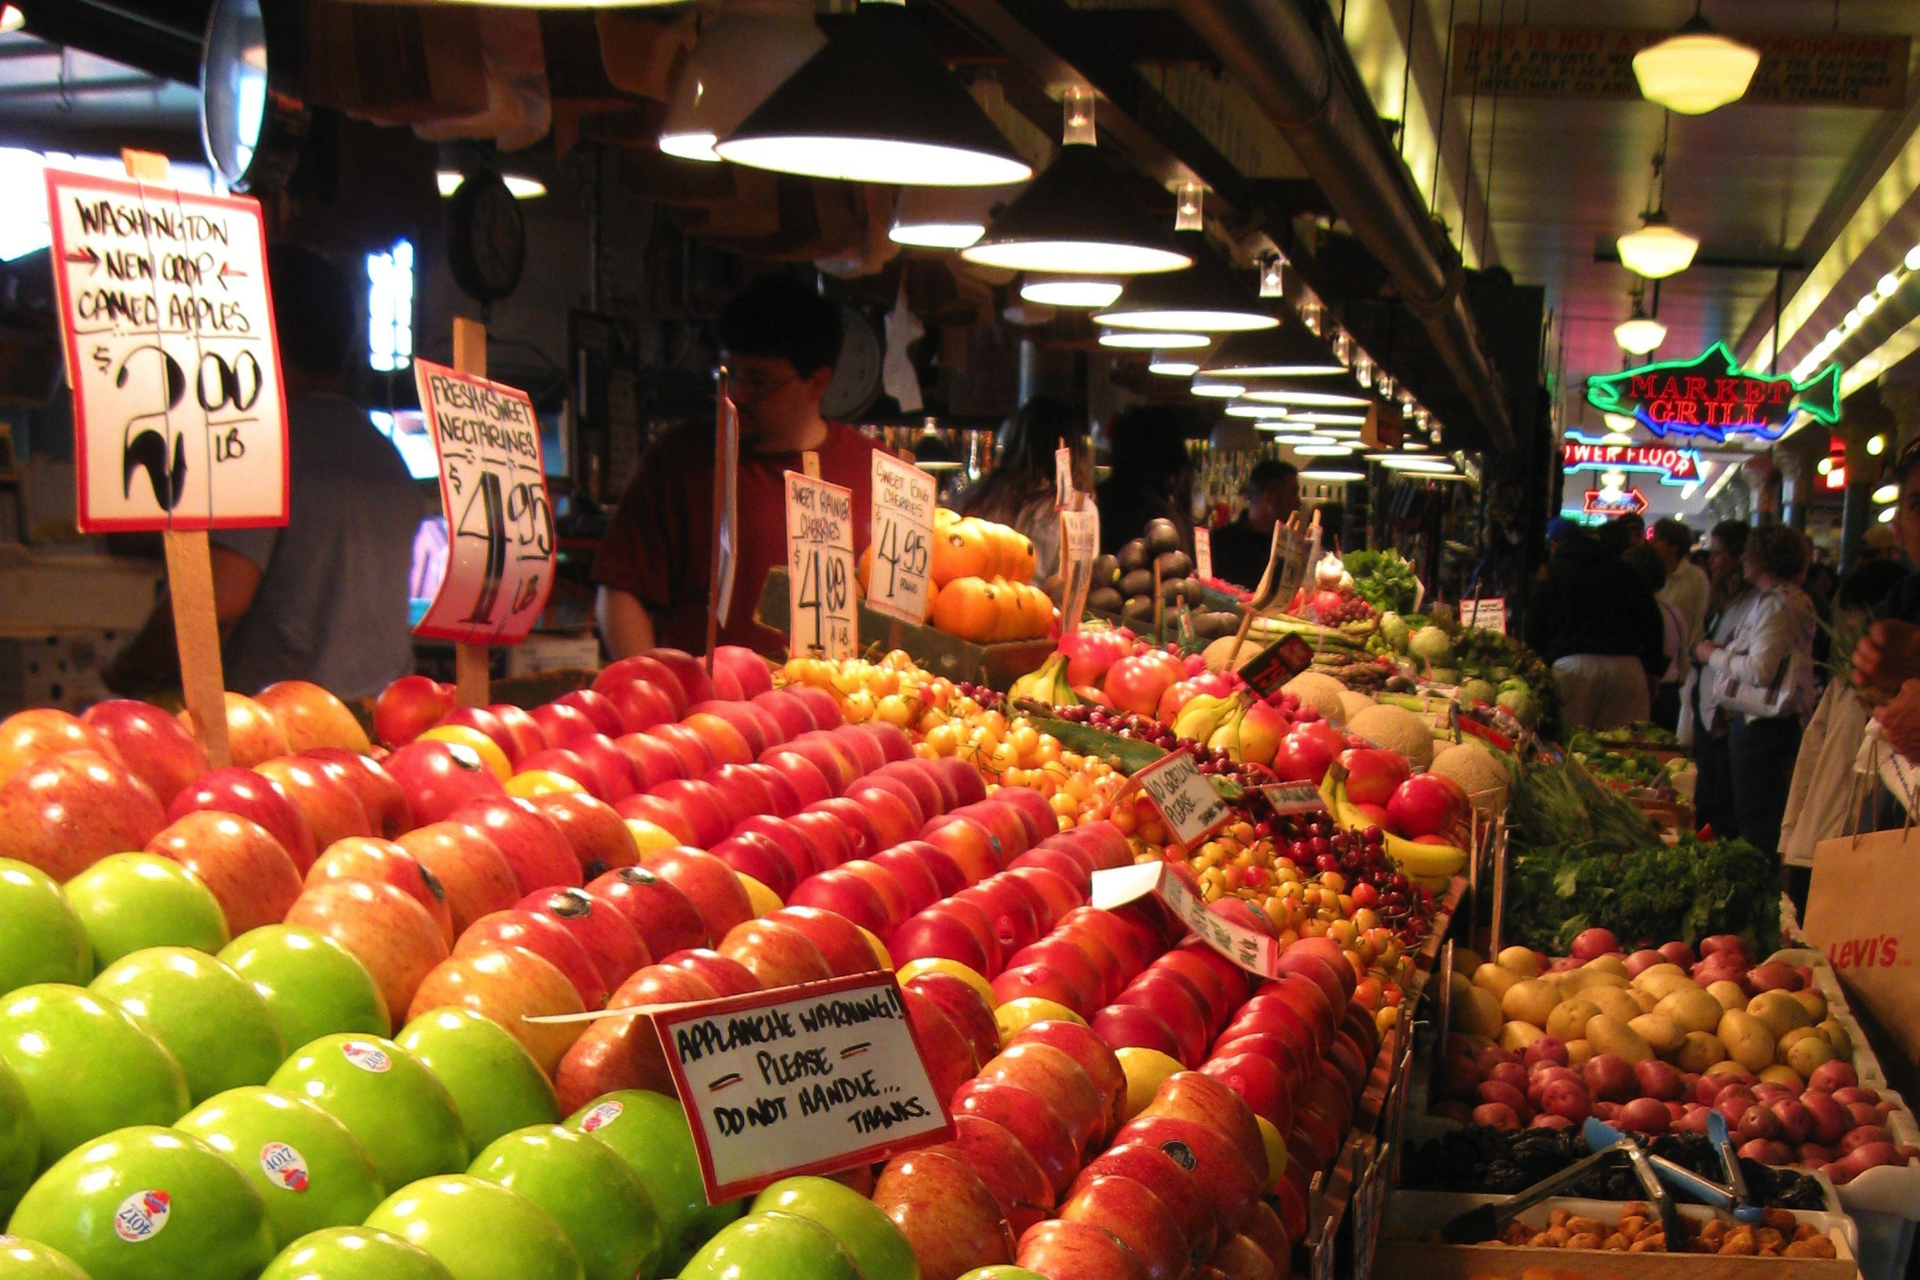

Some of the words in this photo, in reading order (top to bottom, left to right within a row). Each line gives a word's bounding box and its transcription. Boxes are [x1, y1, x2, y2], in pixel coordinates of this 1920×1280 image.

[75, 197, 229, 246] WASHINGTON
[103, 251, 157, 282] NEW
[162, 252, 216, 286] CROP
[168, 293, 251, 334] APPLES
[1629, 374, 1791, 406] MARKET
[1649, 400, 1767, 427] GRILL
[437, 412, 537, 460] NECTARINES
[791, 480, 816, 512] SWEET
[883, 487, 923, 518] CHERRIES
[799, 512, 841, 541] CHERRIES
[756, 1046, 834, 1087] PLEASE
[713, 1106, 745, 1138] DO
[749, 1096, 788, 1127] NOT
[265, 1146, 292, 1171] 4017
[118, 1207, 152, 1236] 4017
